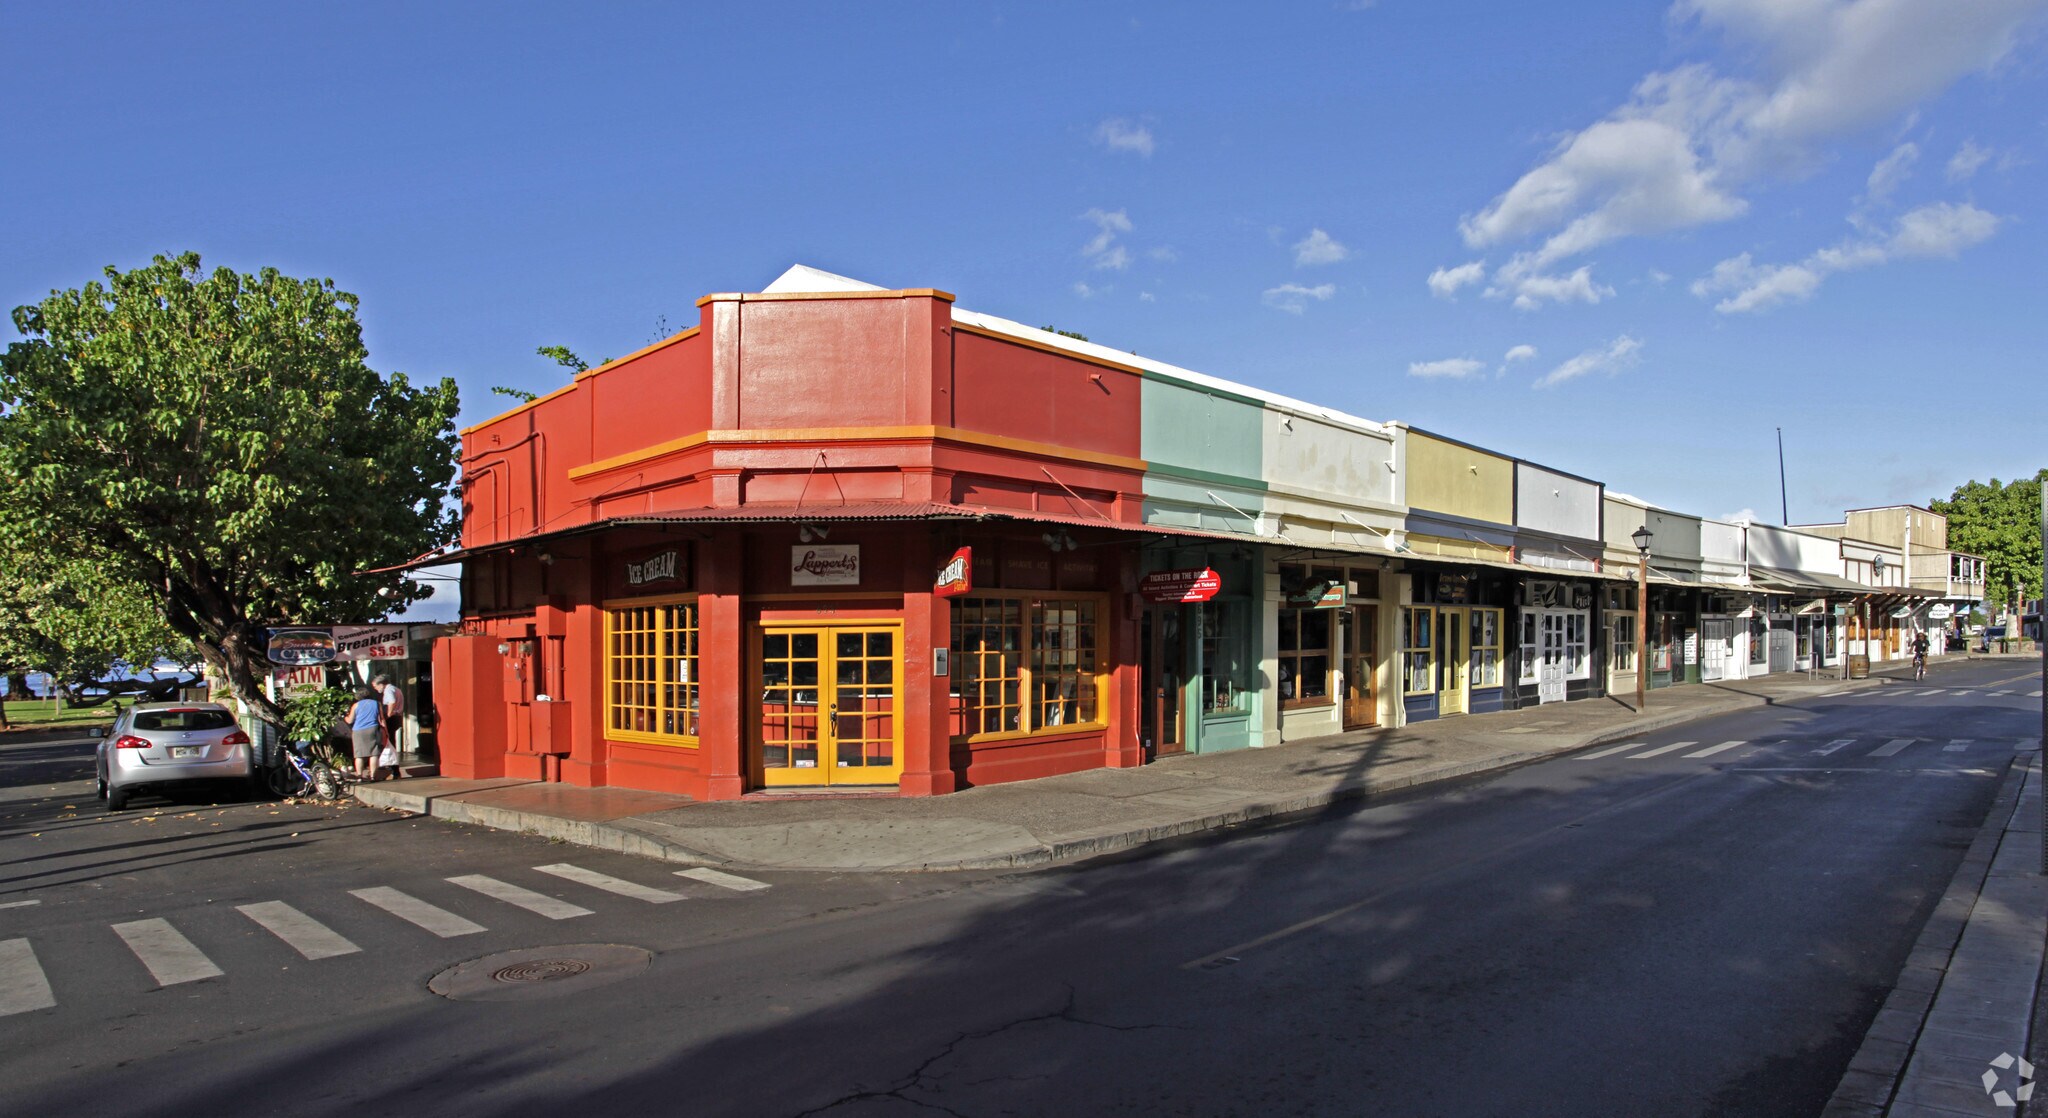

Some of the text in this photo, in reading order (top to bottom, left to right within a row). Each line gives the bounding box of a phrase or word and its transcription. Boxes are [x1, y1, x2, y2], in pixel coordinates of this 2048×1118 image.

[628, 552, 676, 583] ICE CREAM
[946, 557, 964, 584] CREAM
[1150, 573, 1171, 582] TICKETS
[1172, 573, 1180, 581] ON
[337, 629, 404, 653] Breakfast
[338, 627, 378, 640] Complete
[369, 645, 404, 658] $5.95
[288, 666, 322, 684] ATM
